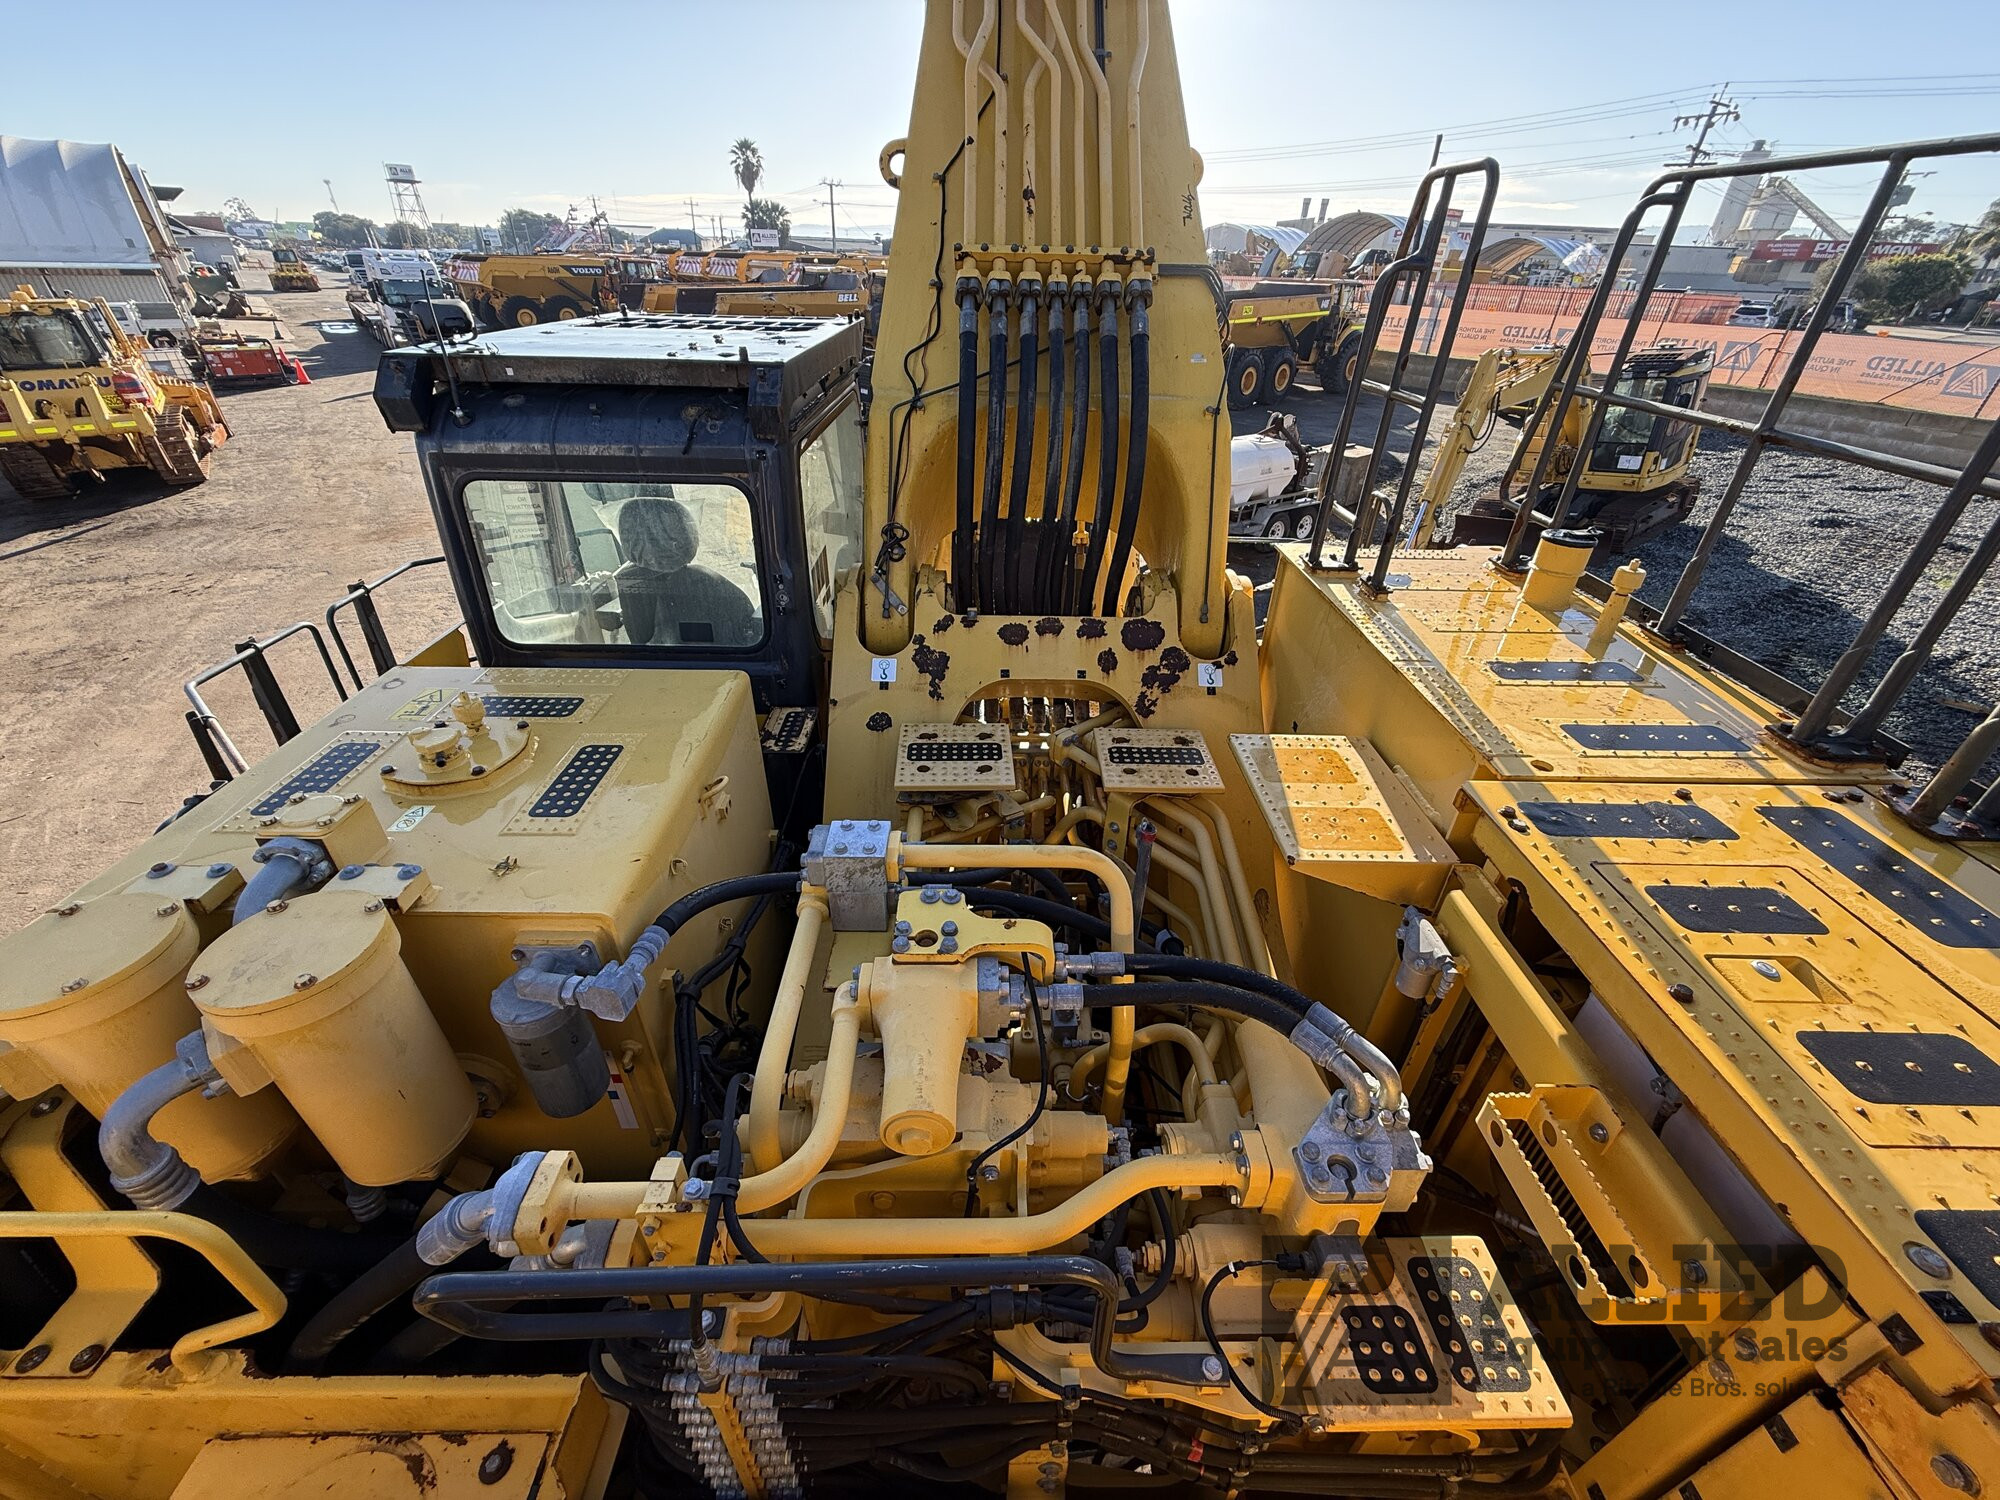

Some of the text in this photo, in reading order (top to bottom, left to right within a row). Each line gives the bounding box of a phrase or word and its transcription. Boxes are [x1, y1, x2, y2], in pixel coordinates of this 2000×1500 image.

[1813, 242, 1917, 255] PLAMAN
[837, 293, 859, 302] BELL
[16, 376, 111, 392] OMATU
